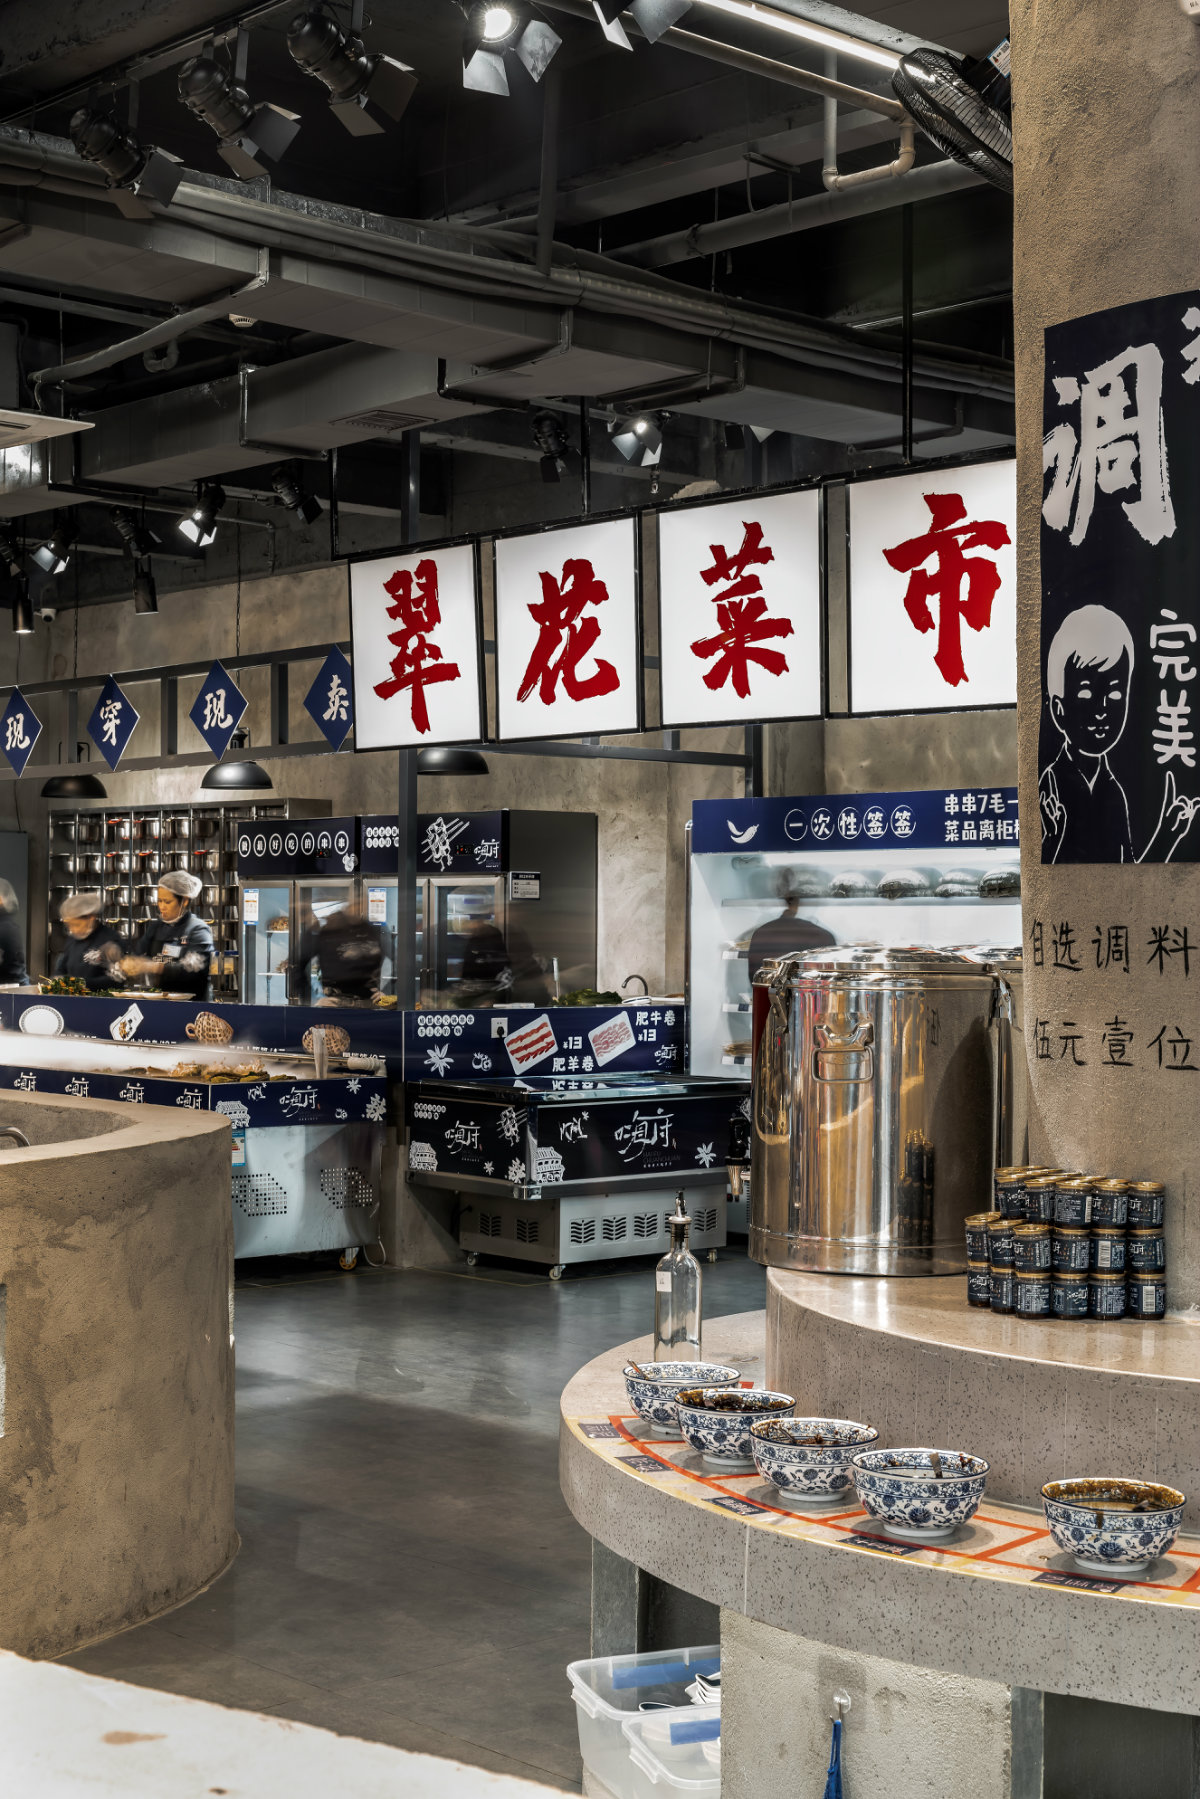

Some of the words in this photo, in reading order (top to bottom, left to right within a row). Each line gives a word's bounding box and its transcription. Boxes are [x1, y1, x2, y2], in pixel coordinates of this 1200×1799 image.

[1043, 342, 1177, 546] 调
[1149, 608, 1197, 768] 完美
[5, 712, 31, 751] 现
[99, 699, 122, 747] 穿
[203, 688, 234, 731] 现
[787, 808, 914, 838] 一次性签签
[944, 819, 1020, 843] 菜品离柜
[1029, 918, 1199, 978] 自选调料
[635, 1010, 676, 1027] 肥牛卷
[1032, 1015, 1200, 1071] 伍元壹位
[552, 1056, 595, 1073] 肥羊卷
